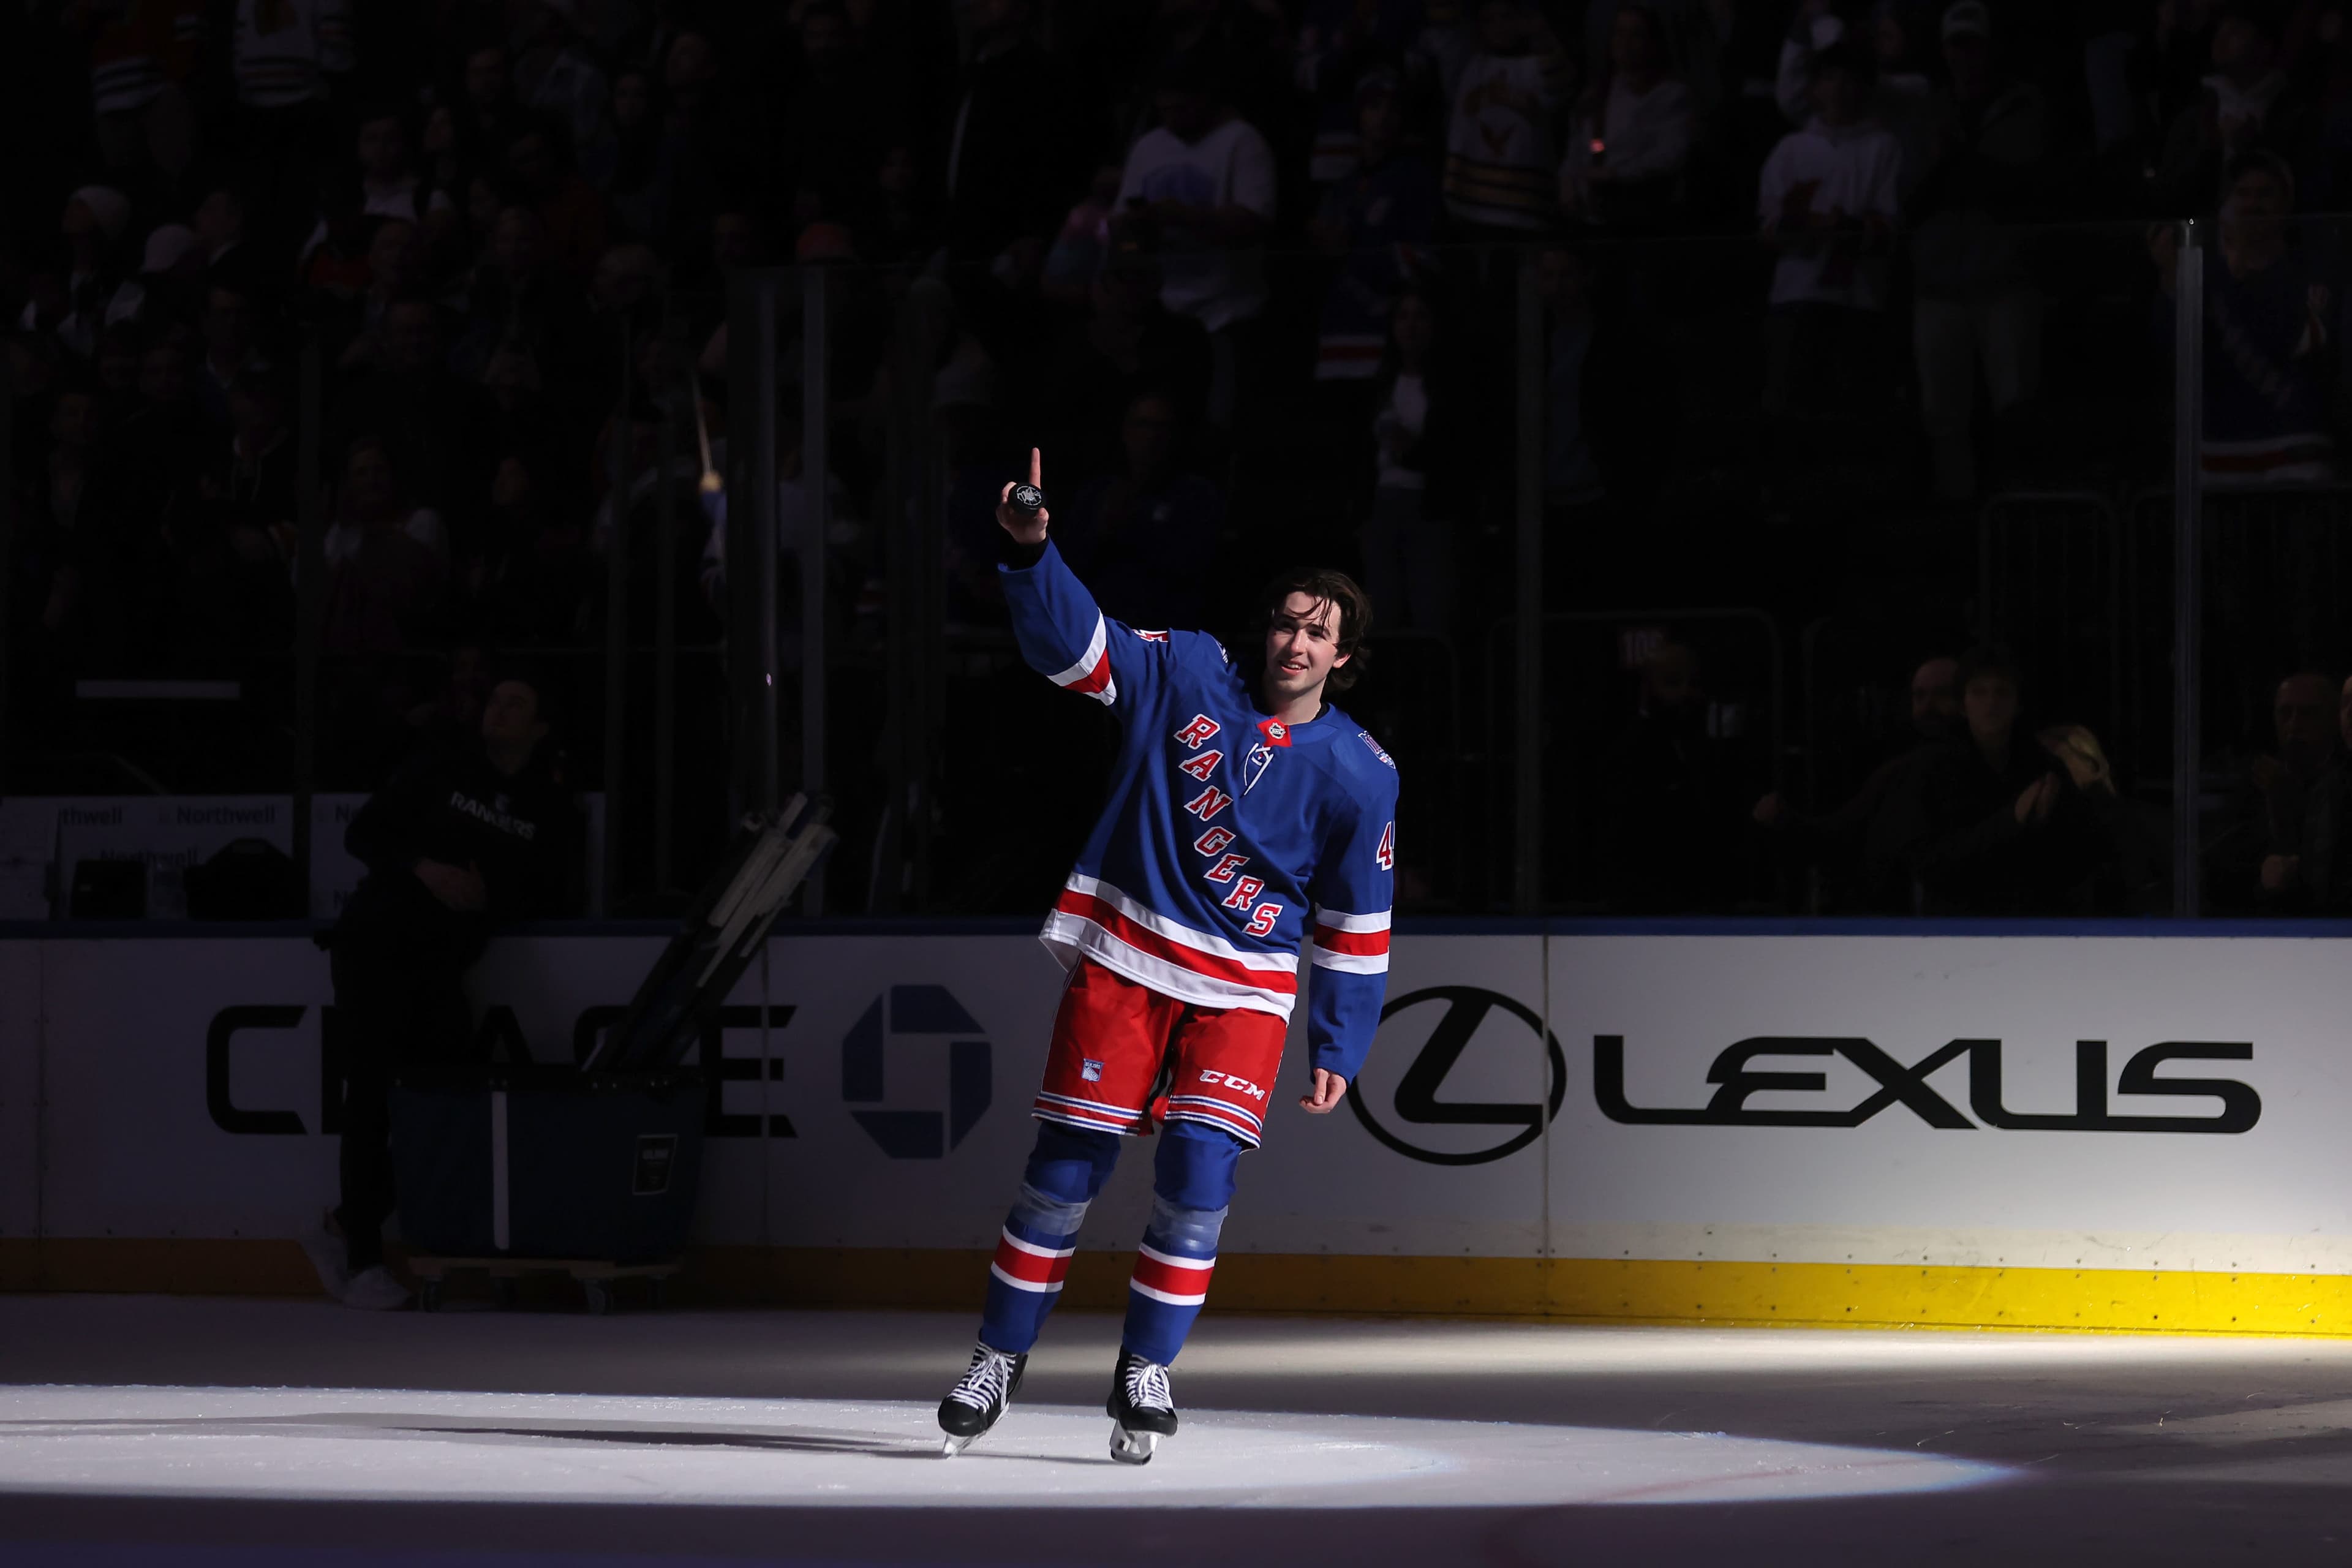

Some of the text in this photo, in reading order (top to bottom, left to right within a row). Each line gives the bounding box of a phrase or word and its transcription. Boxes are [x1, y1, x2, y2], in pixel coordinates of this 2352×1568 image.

[62, 805, 123, 825] thwell
[176, 805, 276, 824] Northwell
[1174, 713, 1283, 937] RANGERS
[1376, 821, 1395, 871] 4
[1199, 1069, 1265, 1101] CCM
[1594, 1036, 2261, 1133] LEXUS
